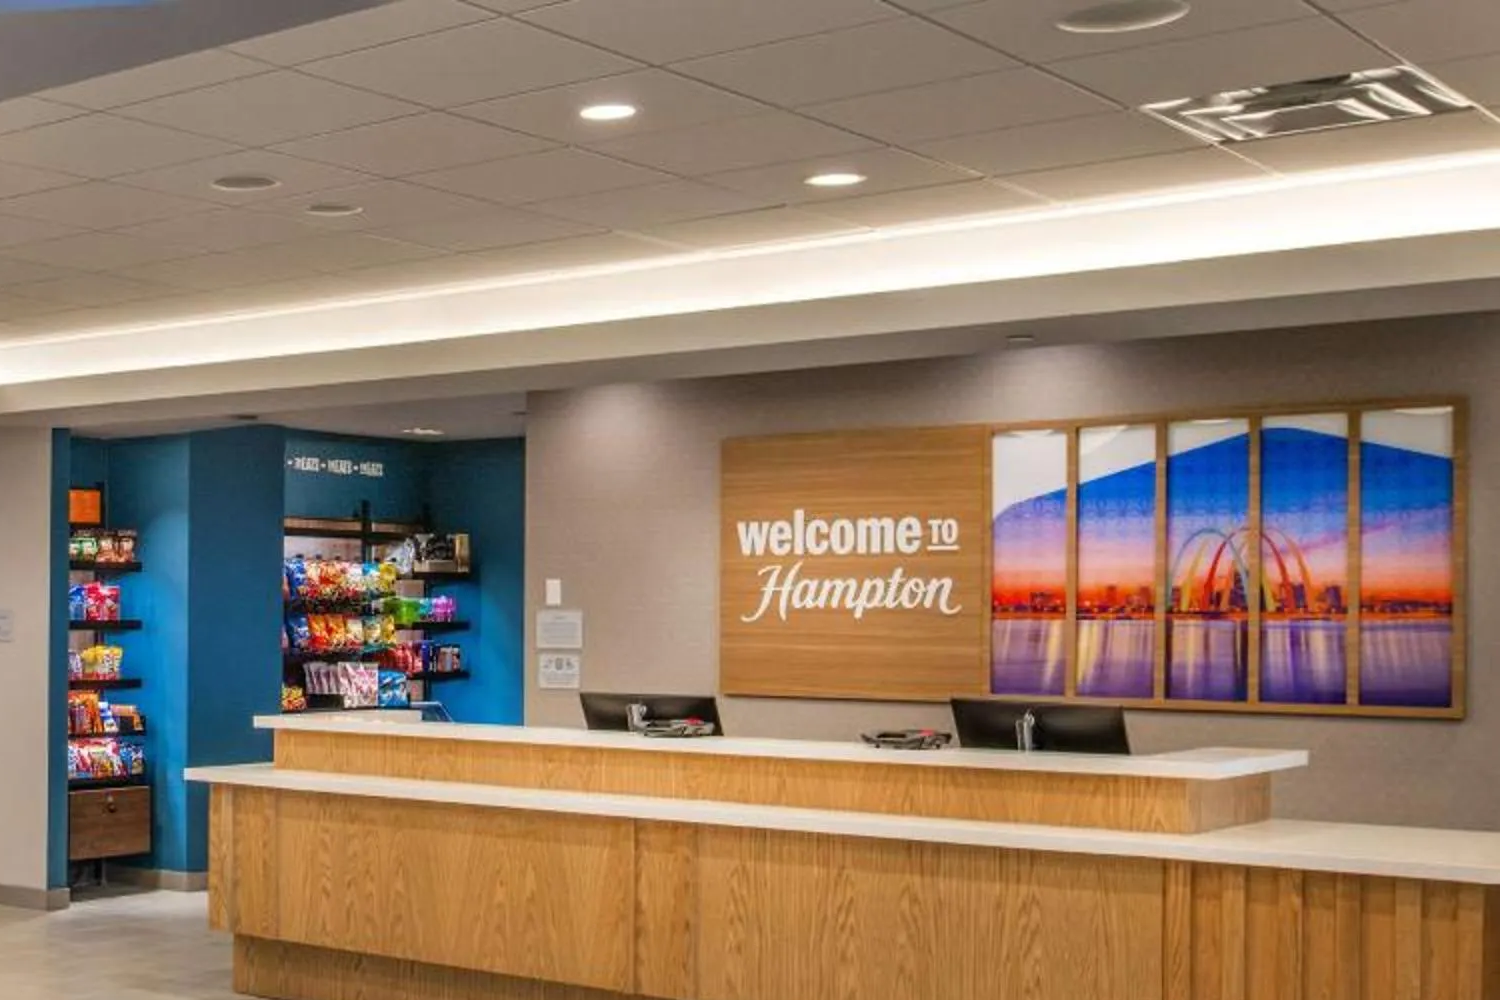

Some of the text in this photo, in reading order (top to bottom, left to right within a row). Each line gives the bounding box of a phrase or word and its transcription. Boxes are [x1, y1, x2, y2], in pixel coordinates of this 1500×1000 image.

[736, 508, 959, 556] welcome TO
[740, 561, 962, 622] Hampton
